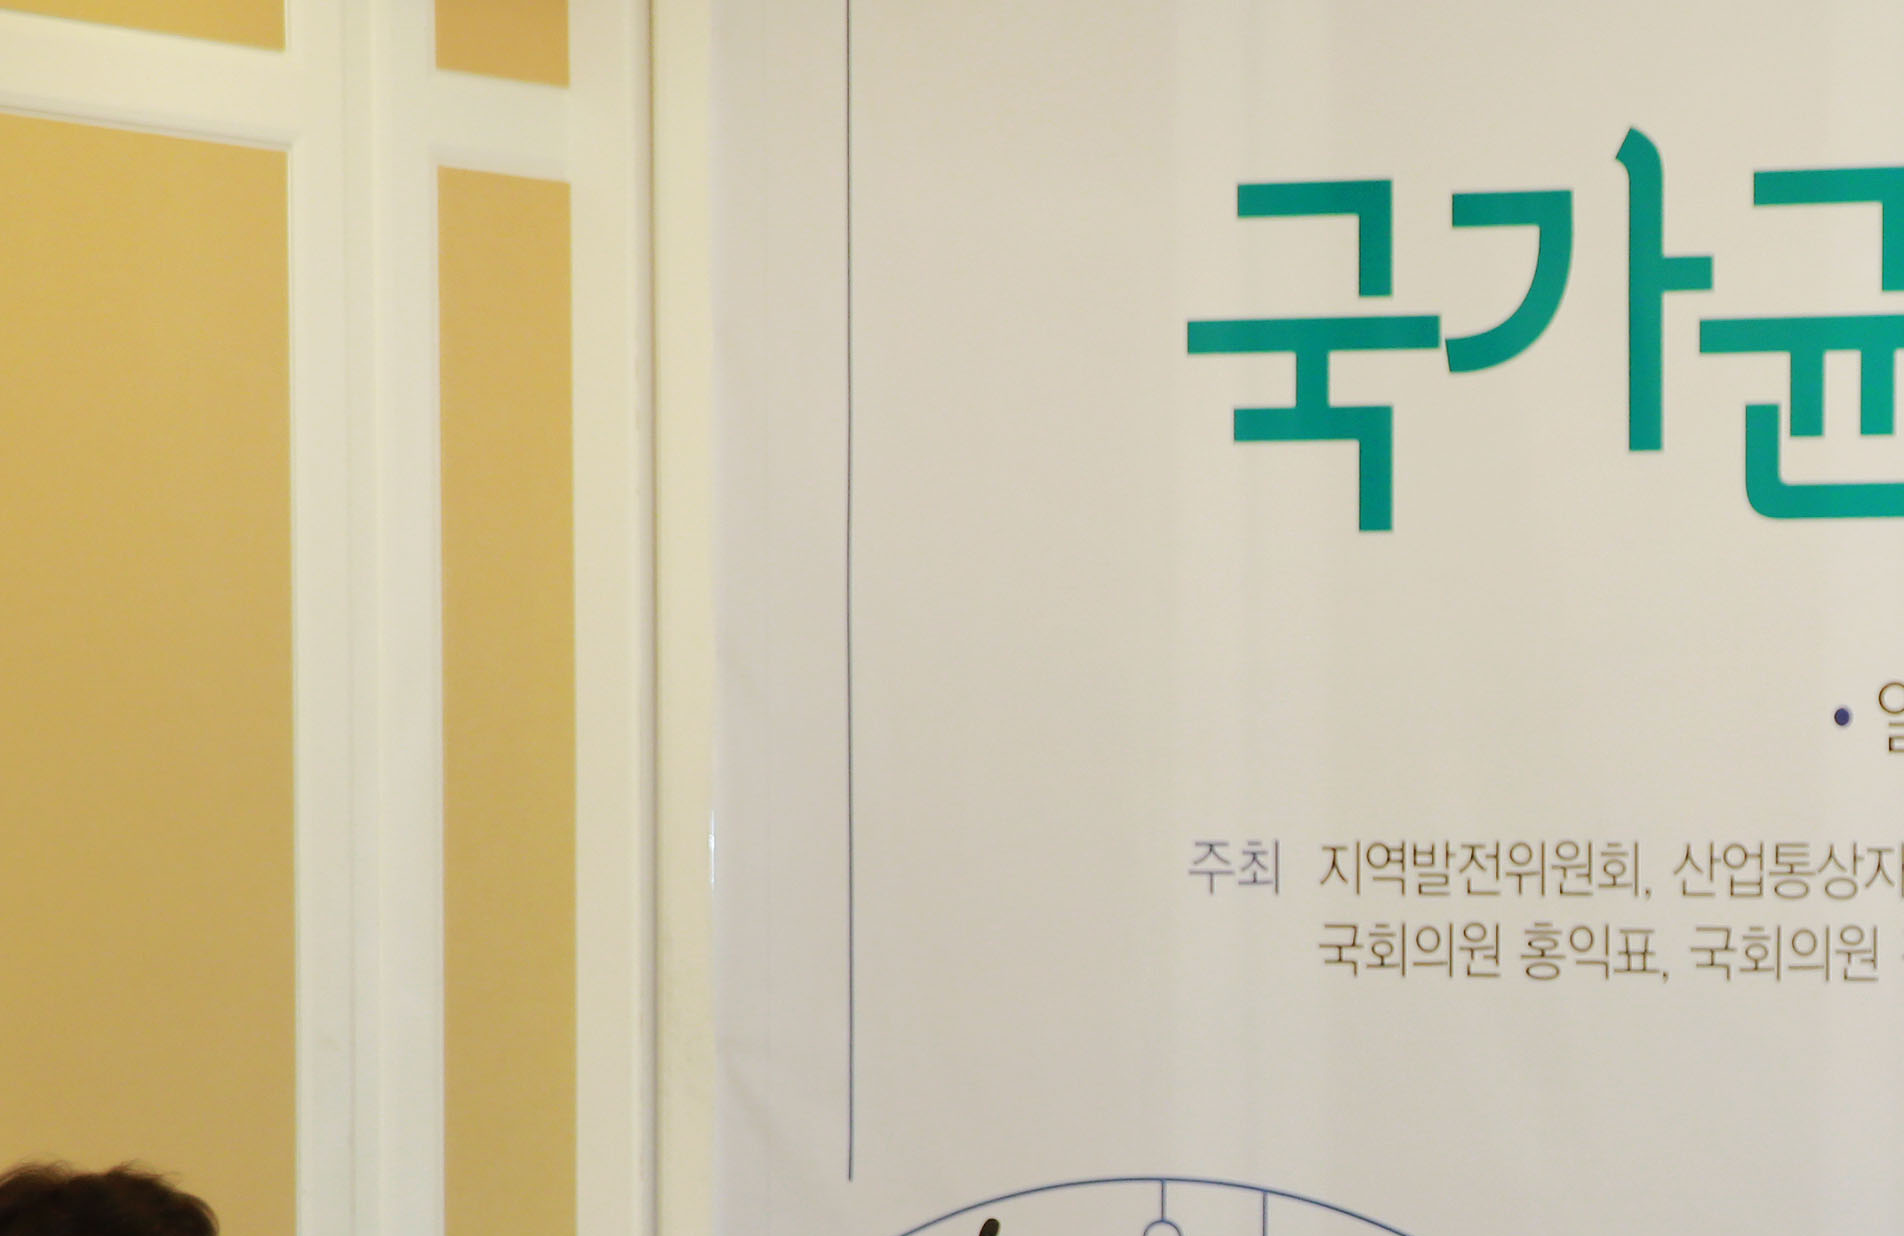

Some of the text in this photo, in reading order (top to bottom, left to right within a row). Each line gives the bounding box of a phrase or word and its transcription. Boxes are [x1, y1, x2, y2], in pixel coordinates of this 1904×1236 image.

[1188, 840, 1280, 895] 주최
[1320, 840, 1651, 898] 지역발전위원회,
[1319, 922, 1500, 979] 국회의원
[1519, 921, 1669, 983] 홍익표,
[1690, 924, 1878, 983] 국회의원
